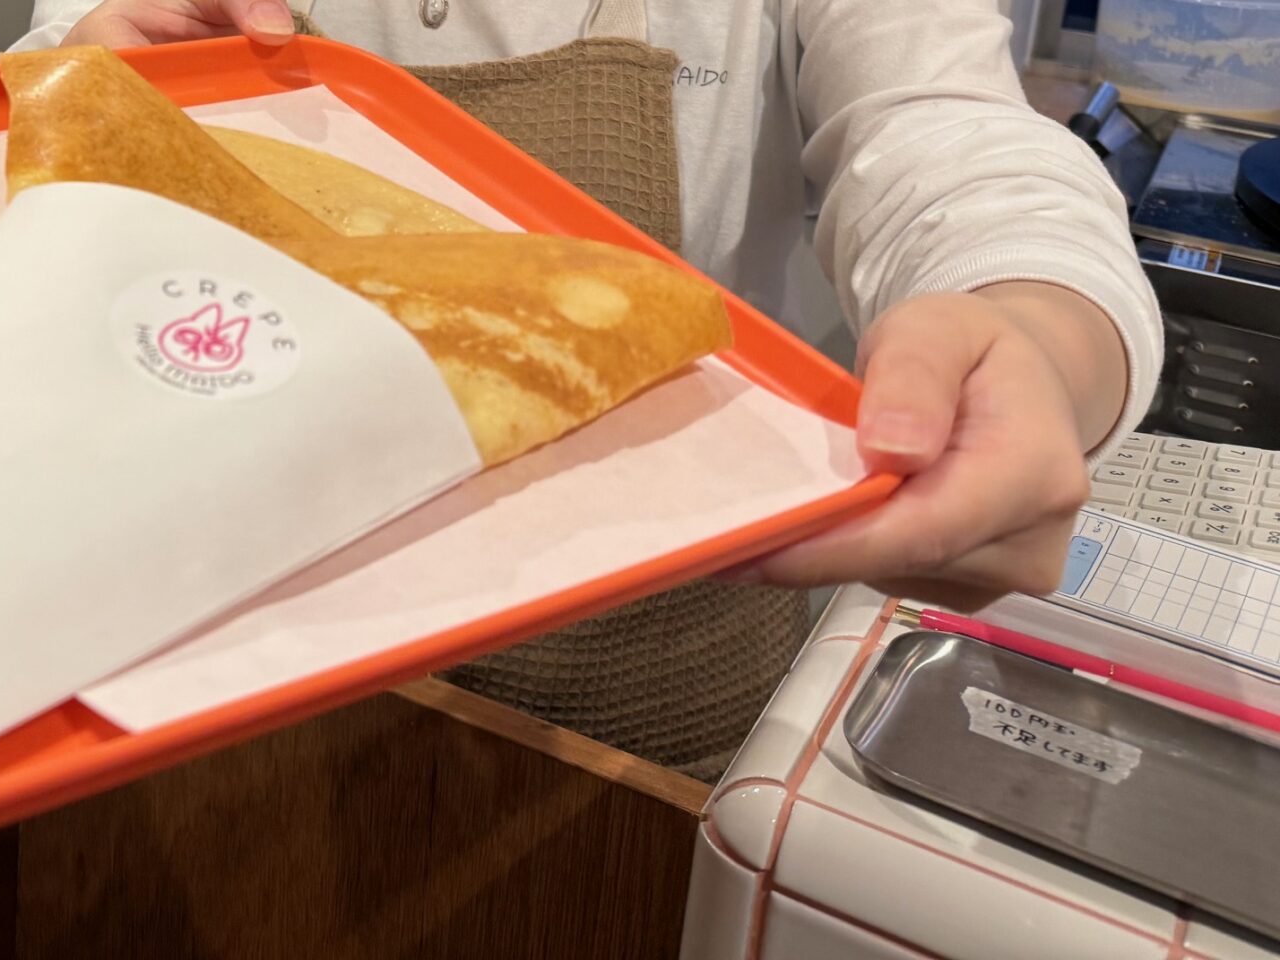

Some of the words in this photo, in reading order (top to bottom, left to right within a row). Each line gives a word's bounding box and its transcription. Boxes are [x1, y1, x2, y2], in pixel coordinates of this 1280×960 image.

[671, 66, 729, 87] AIDO
[161, 278, 297, 352] CREPE
[983, 698, 1076, 736] 100円玉
[992, 720, 1114, 773] 不足してます
